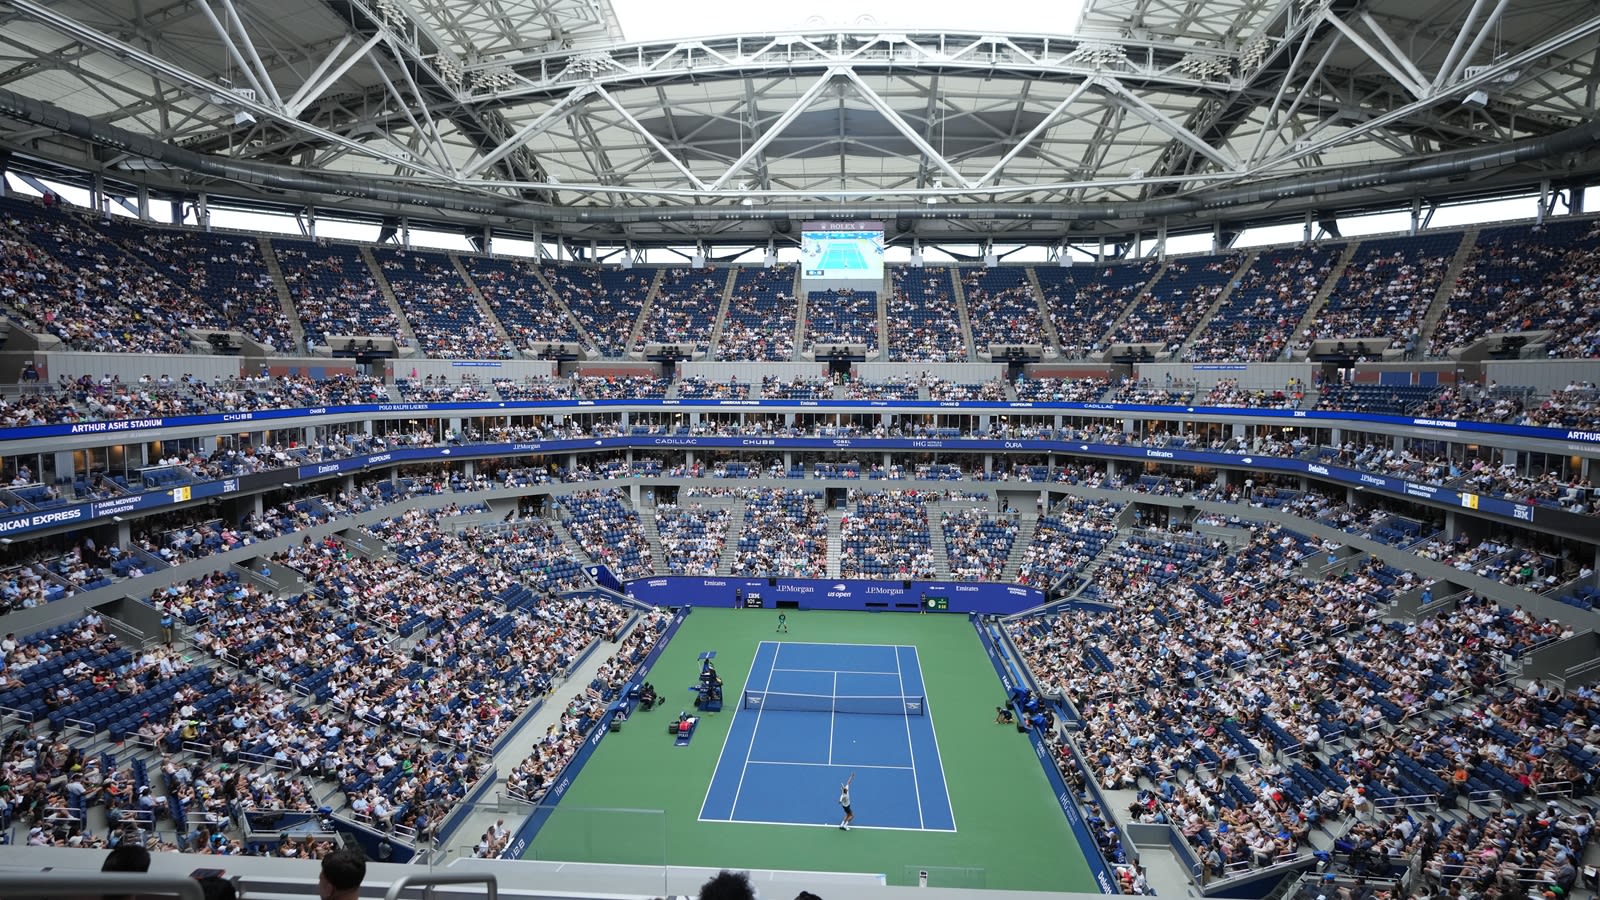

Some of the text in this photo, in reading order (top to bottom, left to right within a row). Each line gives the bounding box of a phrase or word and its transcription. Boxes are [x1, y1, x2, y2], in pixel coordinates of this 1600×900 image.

[223, 413, 253, 421] CHUBB
[72, 418, 163, 433] ARTHUR ASHE STADIUM
[1413, 418, 1457, 428] AMERICAN EXPRESS
[513, 443, 541, 451] J.P.Morgan
[912, 440, 927, 448] IHG
[1146, 449, 1174, 458] Emirates
[318, 463, 340, 474] Emirates
[1360, 474, 1386, 486] J.P.Morgan
[223, 484, 236, 493] IBM
[98, 496, 142, 509] DANIIL MEDVEDEV
[99, 504, 134, 516] HUGO GASTON
[1513, 509, 1529, 520] IBM
[32, 509, 81, 526] EXPRESS
[776, 586, 814, 594] J.P.Morgan
[865, 586, 904, 595] J.P.Morgan
[555, 776, 570, 797] Harvey
[1060, 792, 1071, 810] IHG
